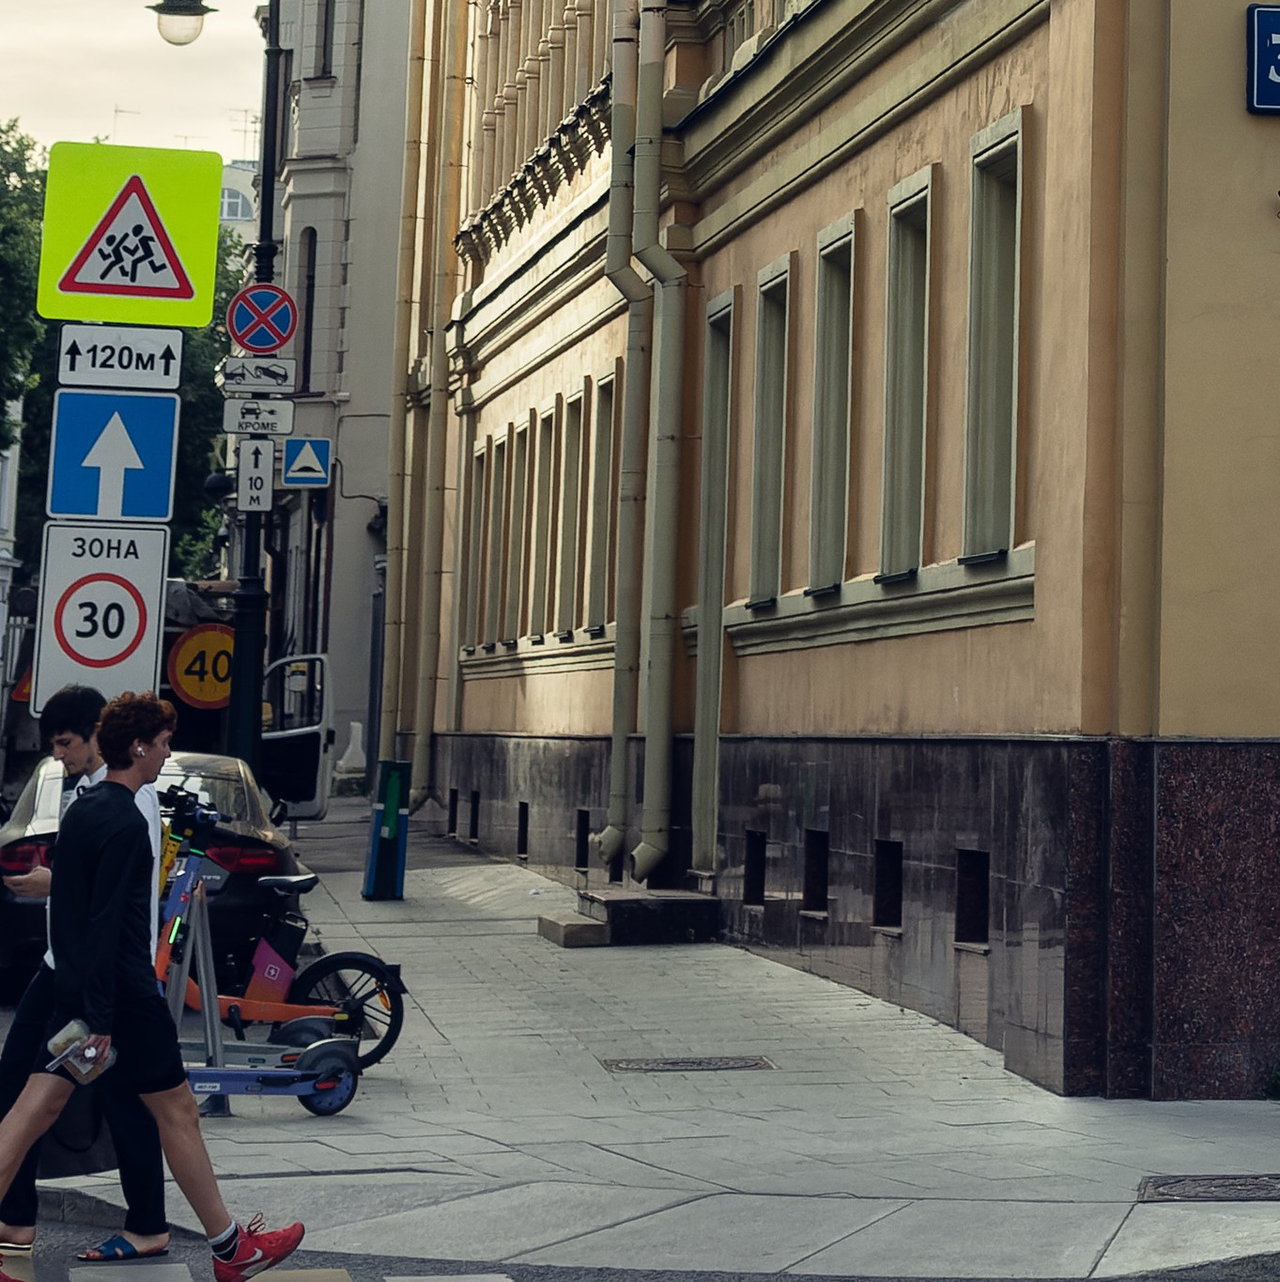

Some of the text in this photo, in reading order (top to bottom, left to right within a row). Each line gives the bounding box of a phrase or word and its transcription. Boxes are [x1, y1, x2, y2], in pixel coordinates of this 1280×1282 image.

[238, 421, 278, 432] КРОМЕ
[247, 476, 264, 491] 10
[72, 537, 140, 560] ЗОНА
[75, 601, 125, 639] 30
[184, 650, 232, 683] 40
